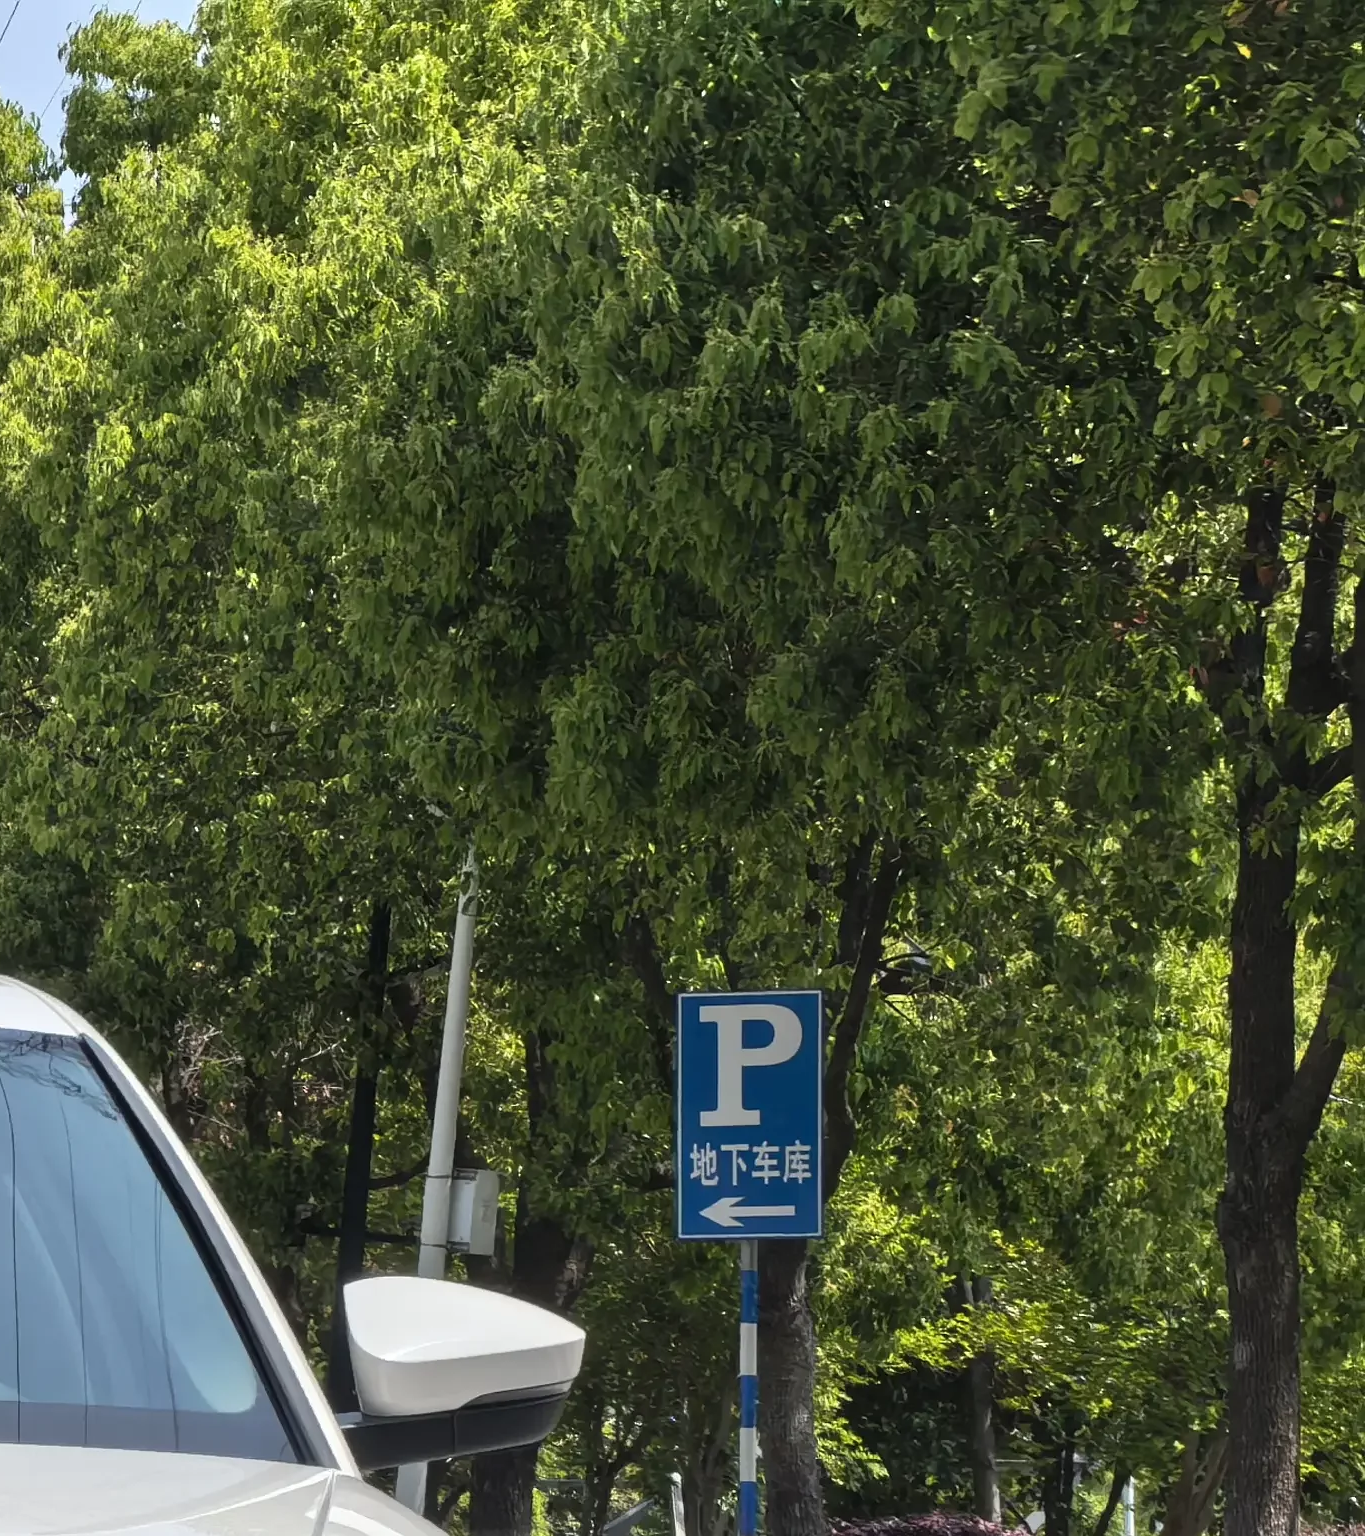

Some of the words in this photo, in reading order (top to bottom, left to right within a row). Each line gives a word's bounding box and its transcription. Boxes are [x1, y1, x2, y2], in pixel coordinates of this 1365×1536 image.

[699, 1003, 803, 1127] P
[690, 1140, 812, 1187] 地下车库
